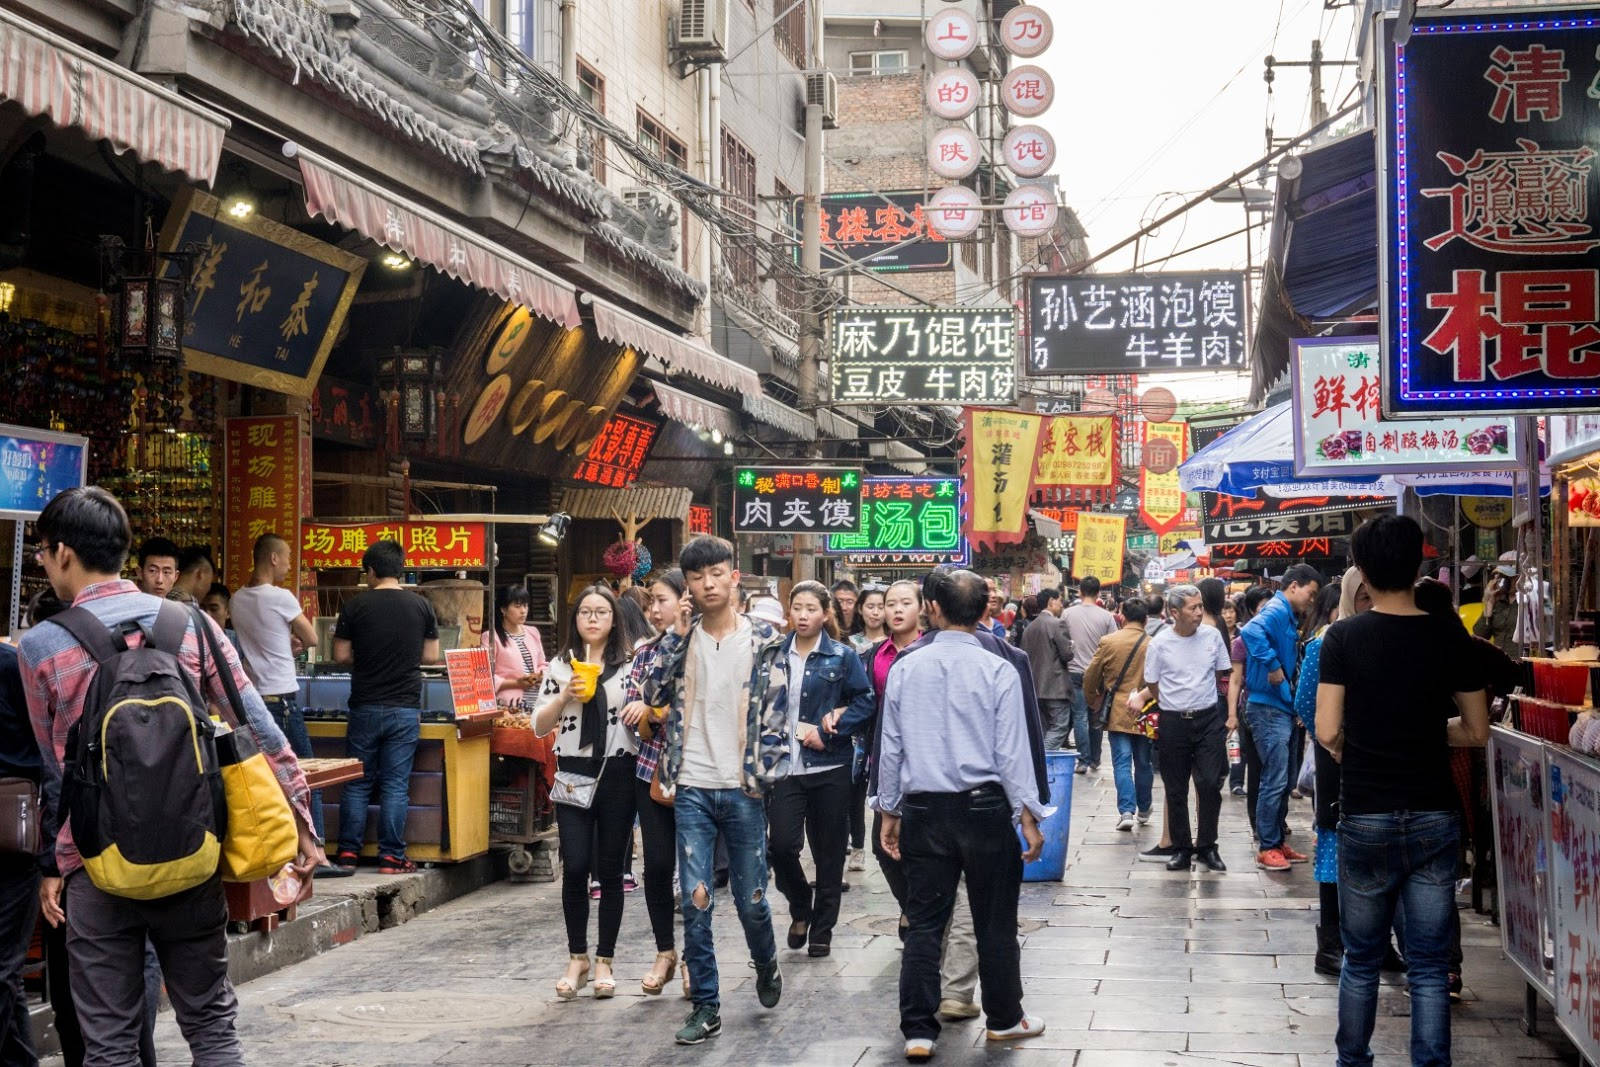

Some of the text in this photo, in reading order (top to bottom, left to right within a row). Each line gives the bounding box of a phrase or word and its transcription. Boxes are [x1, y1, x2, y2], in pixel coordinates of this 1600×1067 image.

[937, 22, 969, 222] 上的陕西
[1040, 280, 1237, 331] 孙艺涵泡馍
[836, 315, 1012, 358] 麻乃馄饨
[1125, 331, 1243, 367] 牛羊肉
[842, 366, 906, 398] 豆皮
[1365, 430, 1459, 454] 自制酸梅汤
[247, 423, 278, 573] 现场雕刻
[739, 497, 856, 528] 肉夹馍
